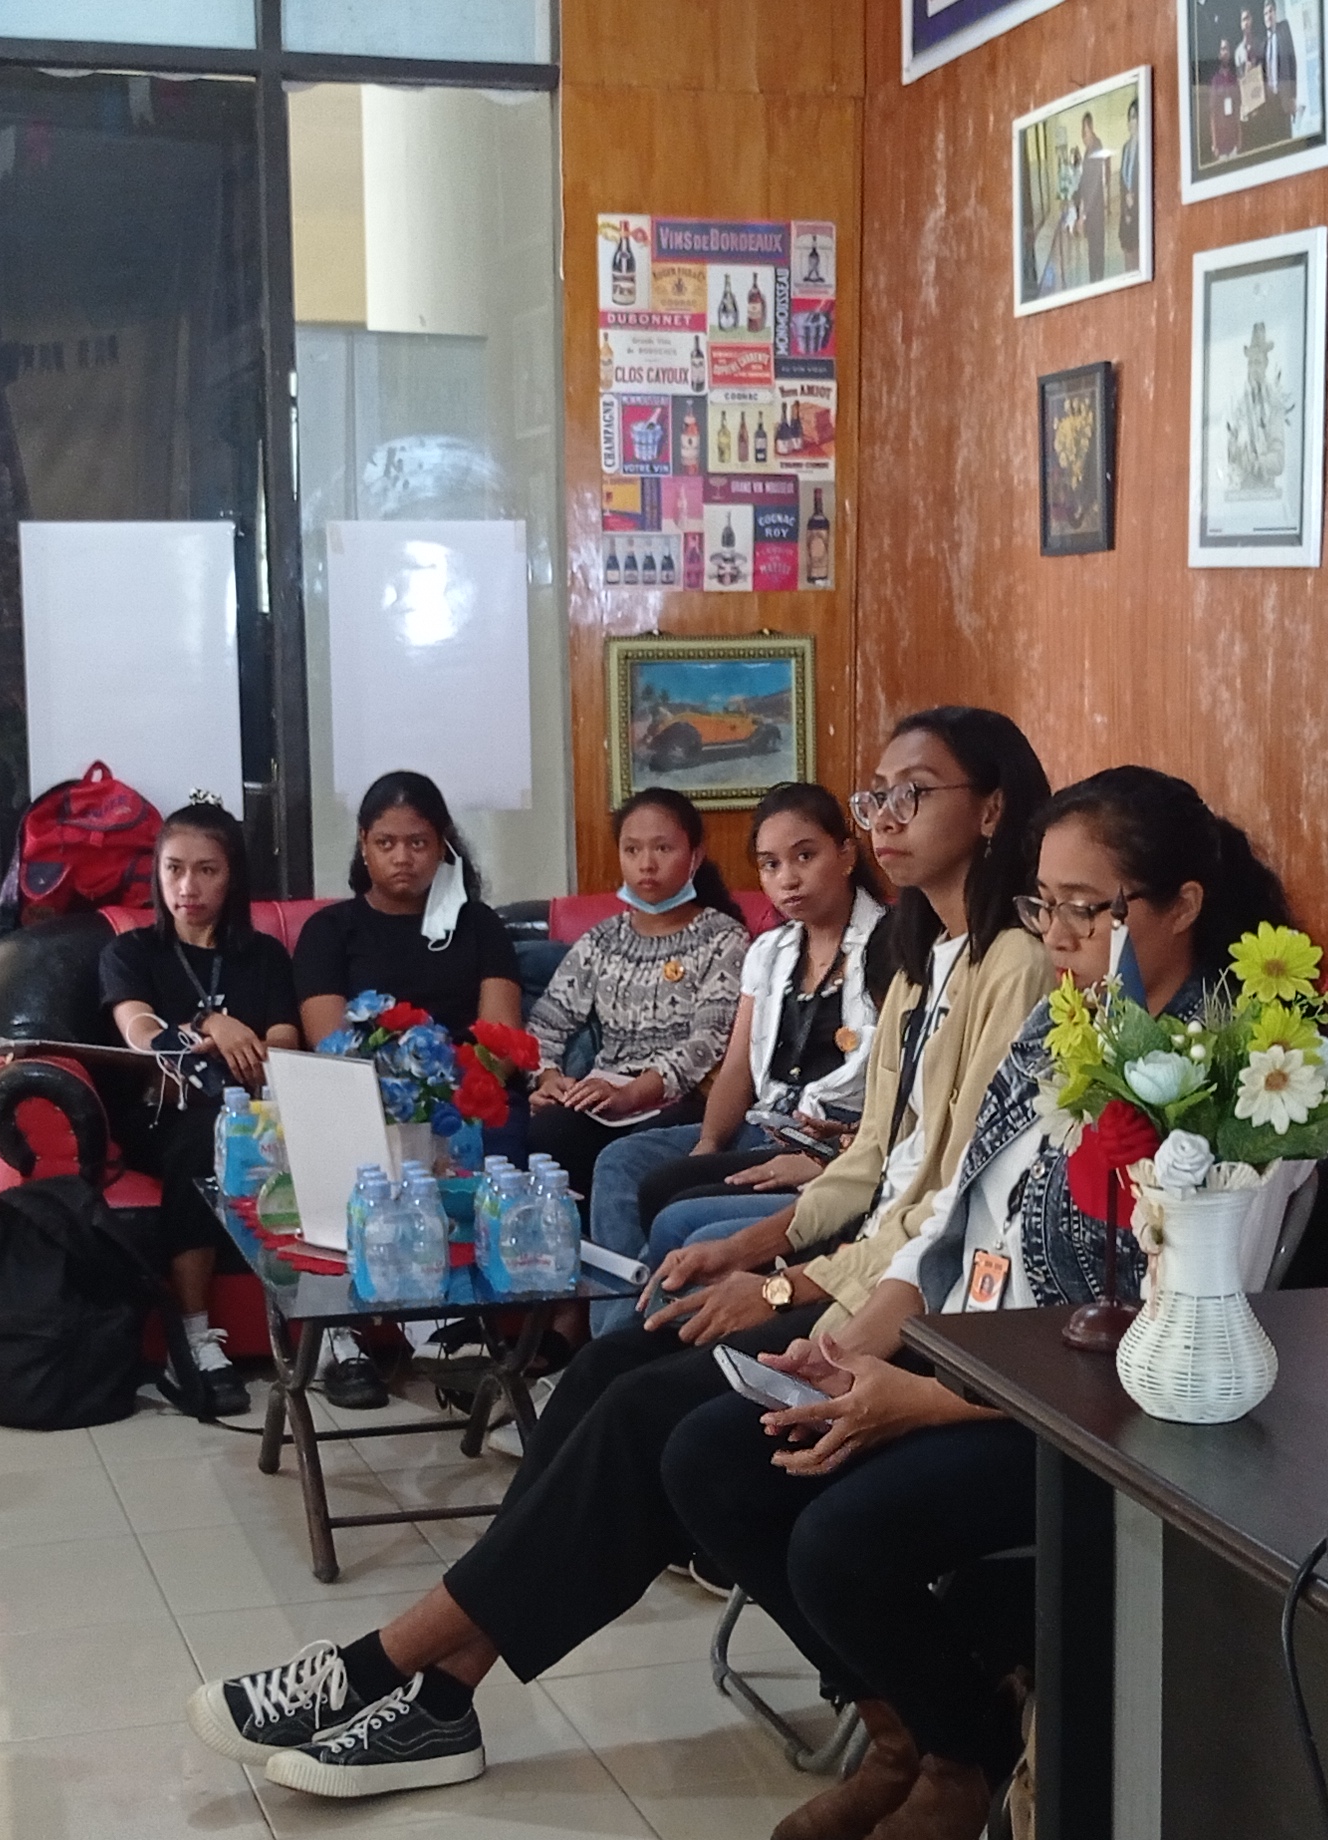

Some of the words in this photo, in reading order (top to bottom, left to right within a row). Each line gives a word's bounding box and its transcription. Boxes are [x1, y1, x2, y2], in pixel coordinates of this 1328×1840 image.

[659, 226, 693, 251] VINS
[709, 228, 783, 253] BORDEAUX
[606, 312, 693, 327] DUBONNET
[614, 366, 645, 384] CLOS
[603, 400, 615, 468] CHAMPAGNE
[623, 463, 652, 474] VOTRE
[653, 464, 670, 474] VIN
[758, 513, 797, 527] COGNAC
[764, 527, 789, 539] ROY
